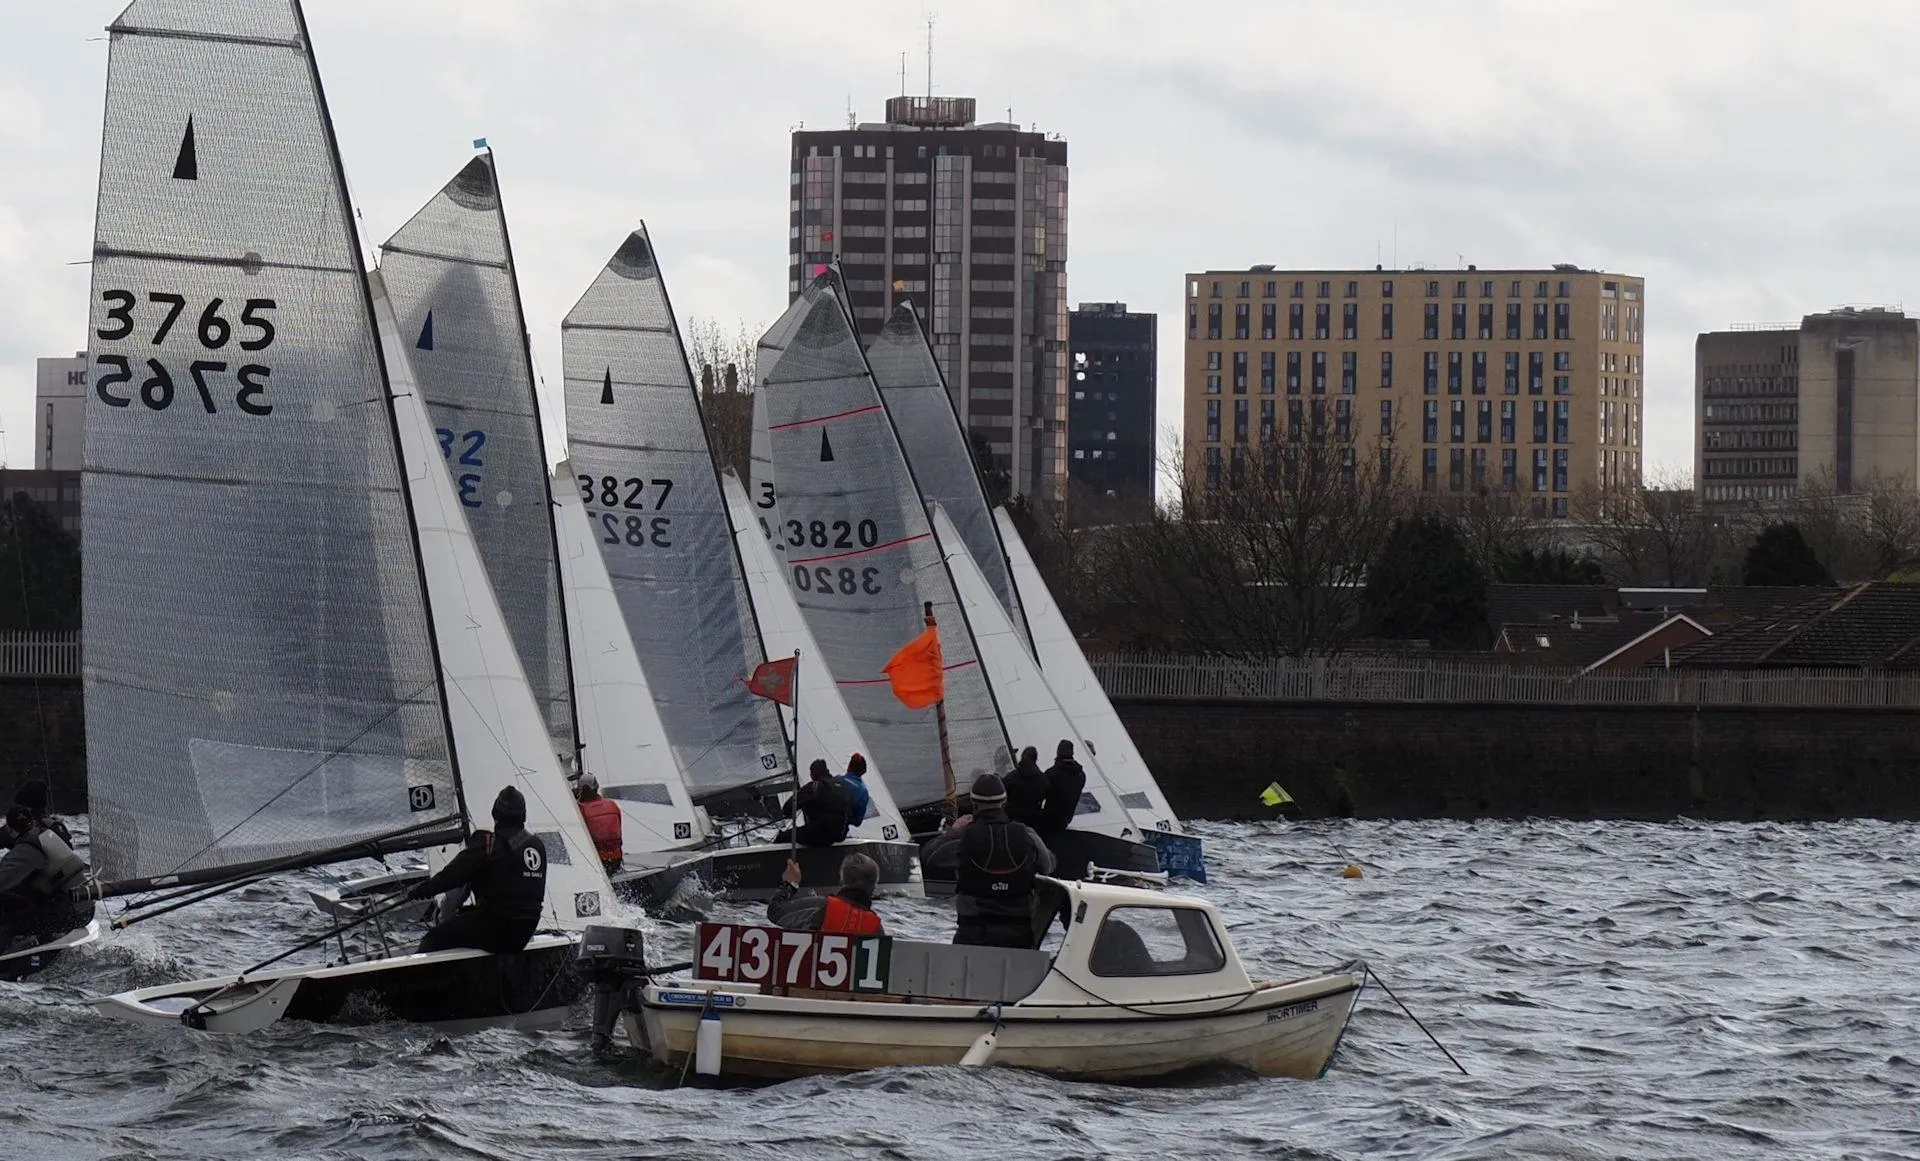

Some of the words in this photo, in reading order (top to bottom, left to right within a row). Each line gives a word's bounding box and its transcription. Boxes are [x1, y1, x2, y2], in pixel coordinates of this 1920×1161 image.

[97, 289, 276, 351] 3765
[578, 474, 673, 510] 3827
[787, 519, 878, 548] 3820
